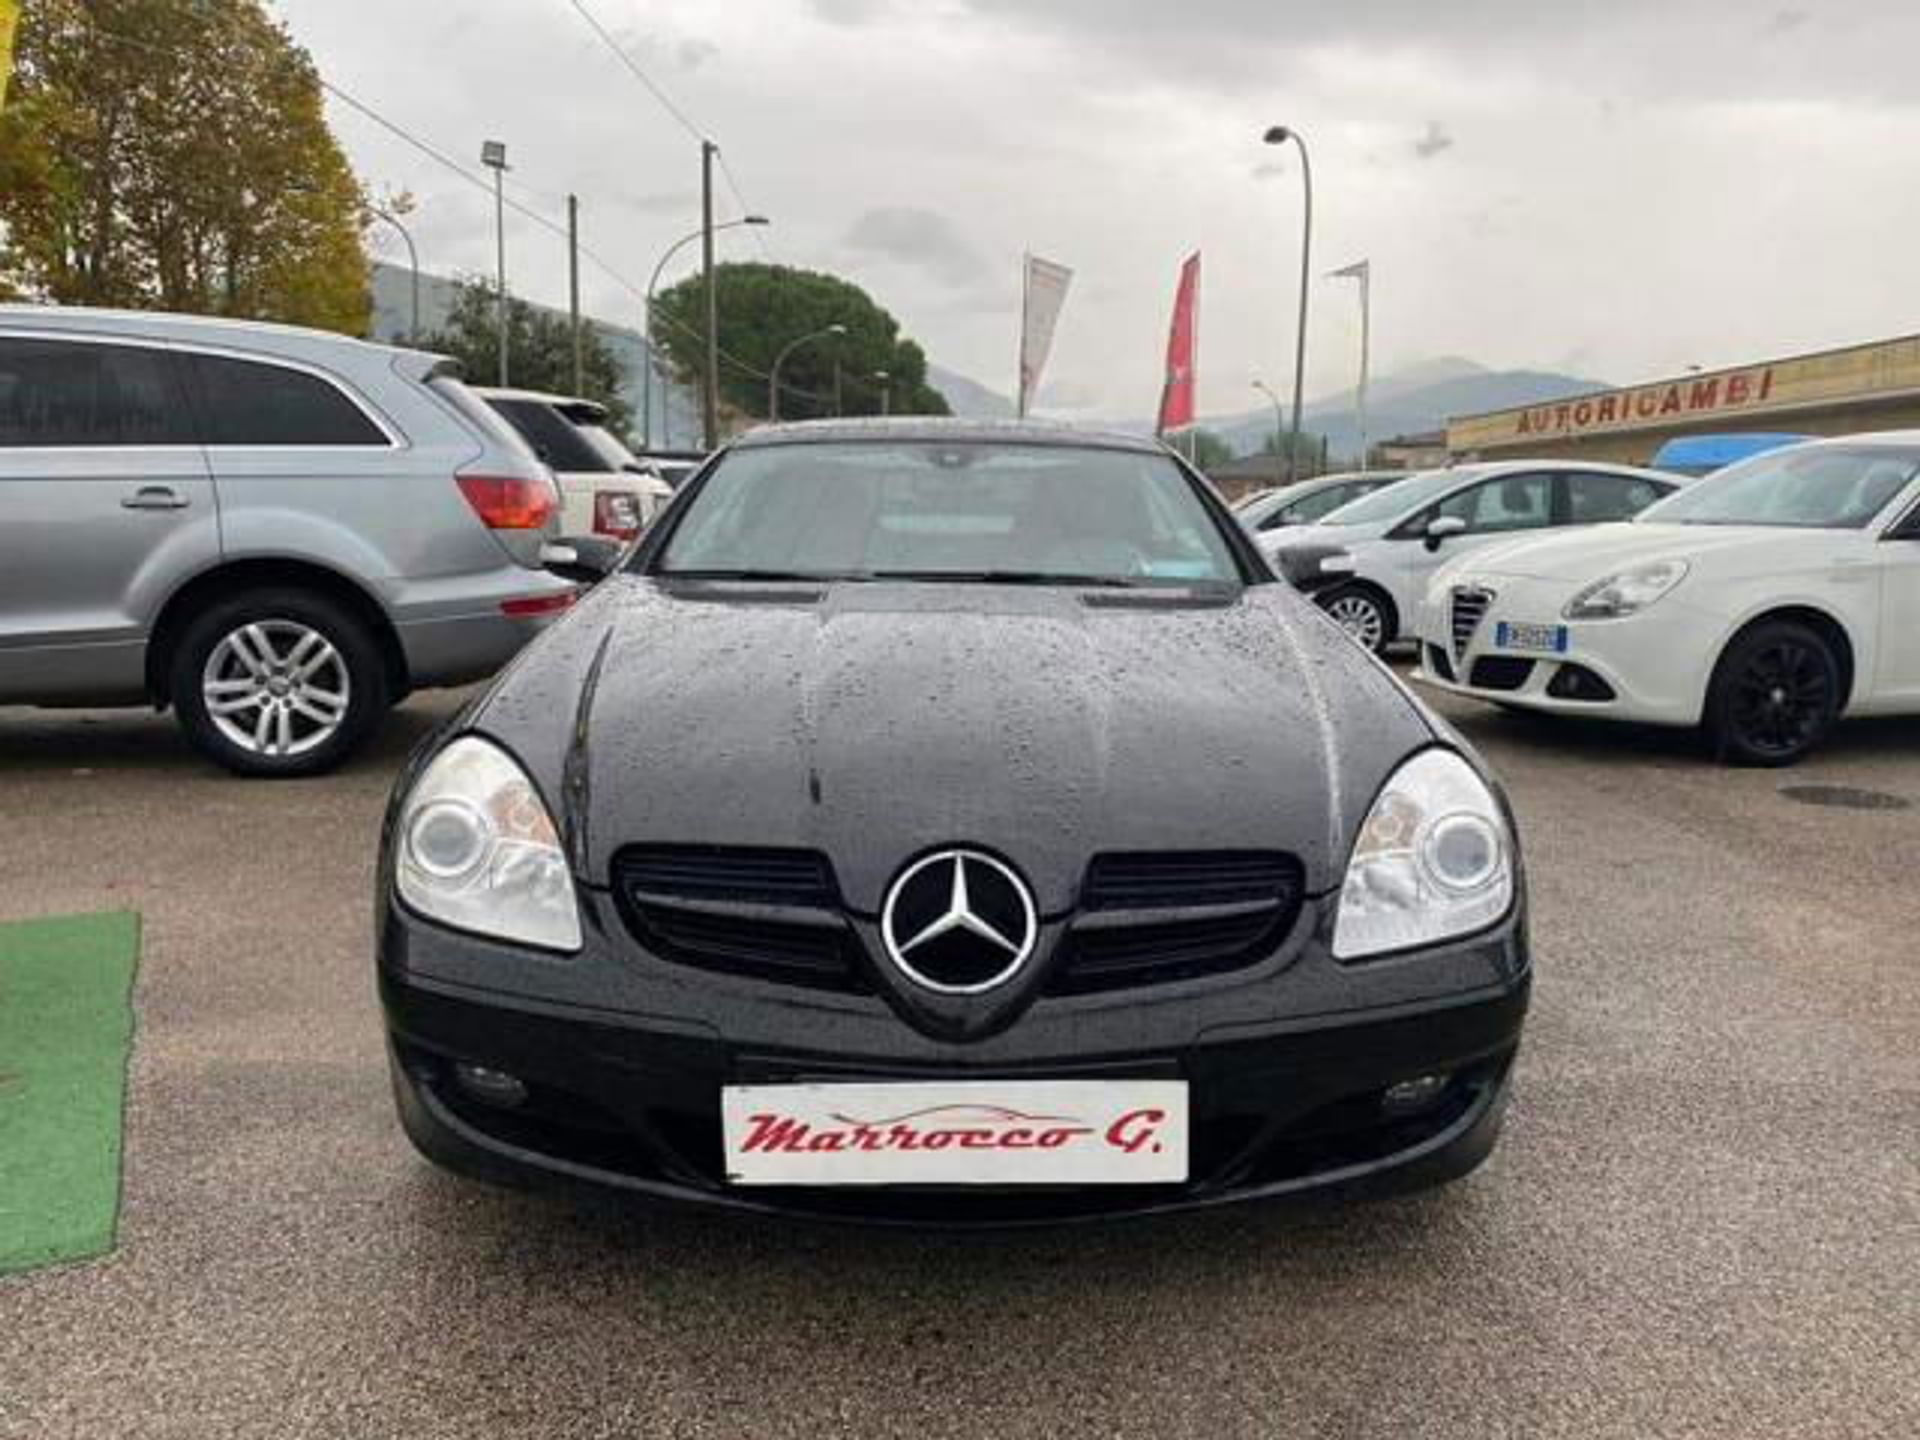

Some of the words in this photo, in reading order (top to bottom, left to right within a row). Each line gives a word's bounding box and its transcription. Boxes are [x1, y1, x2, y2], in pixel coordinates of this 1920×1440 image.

[1516, 370, 1775, 433] AUTORICAMBI
[740, 1113, 1094, 1152] Marrocco
[1106, 1109, 1163, 1153] G.
